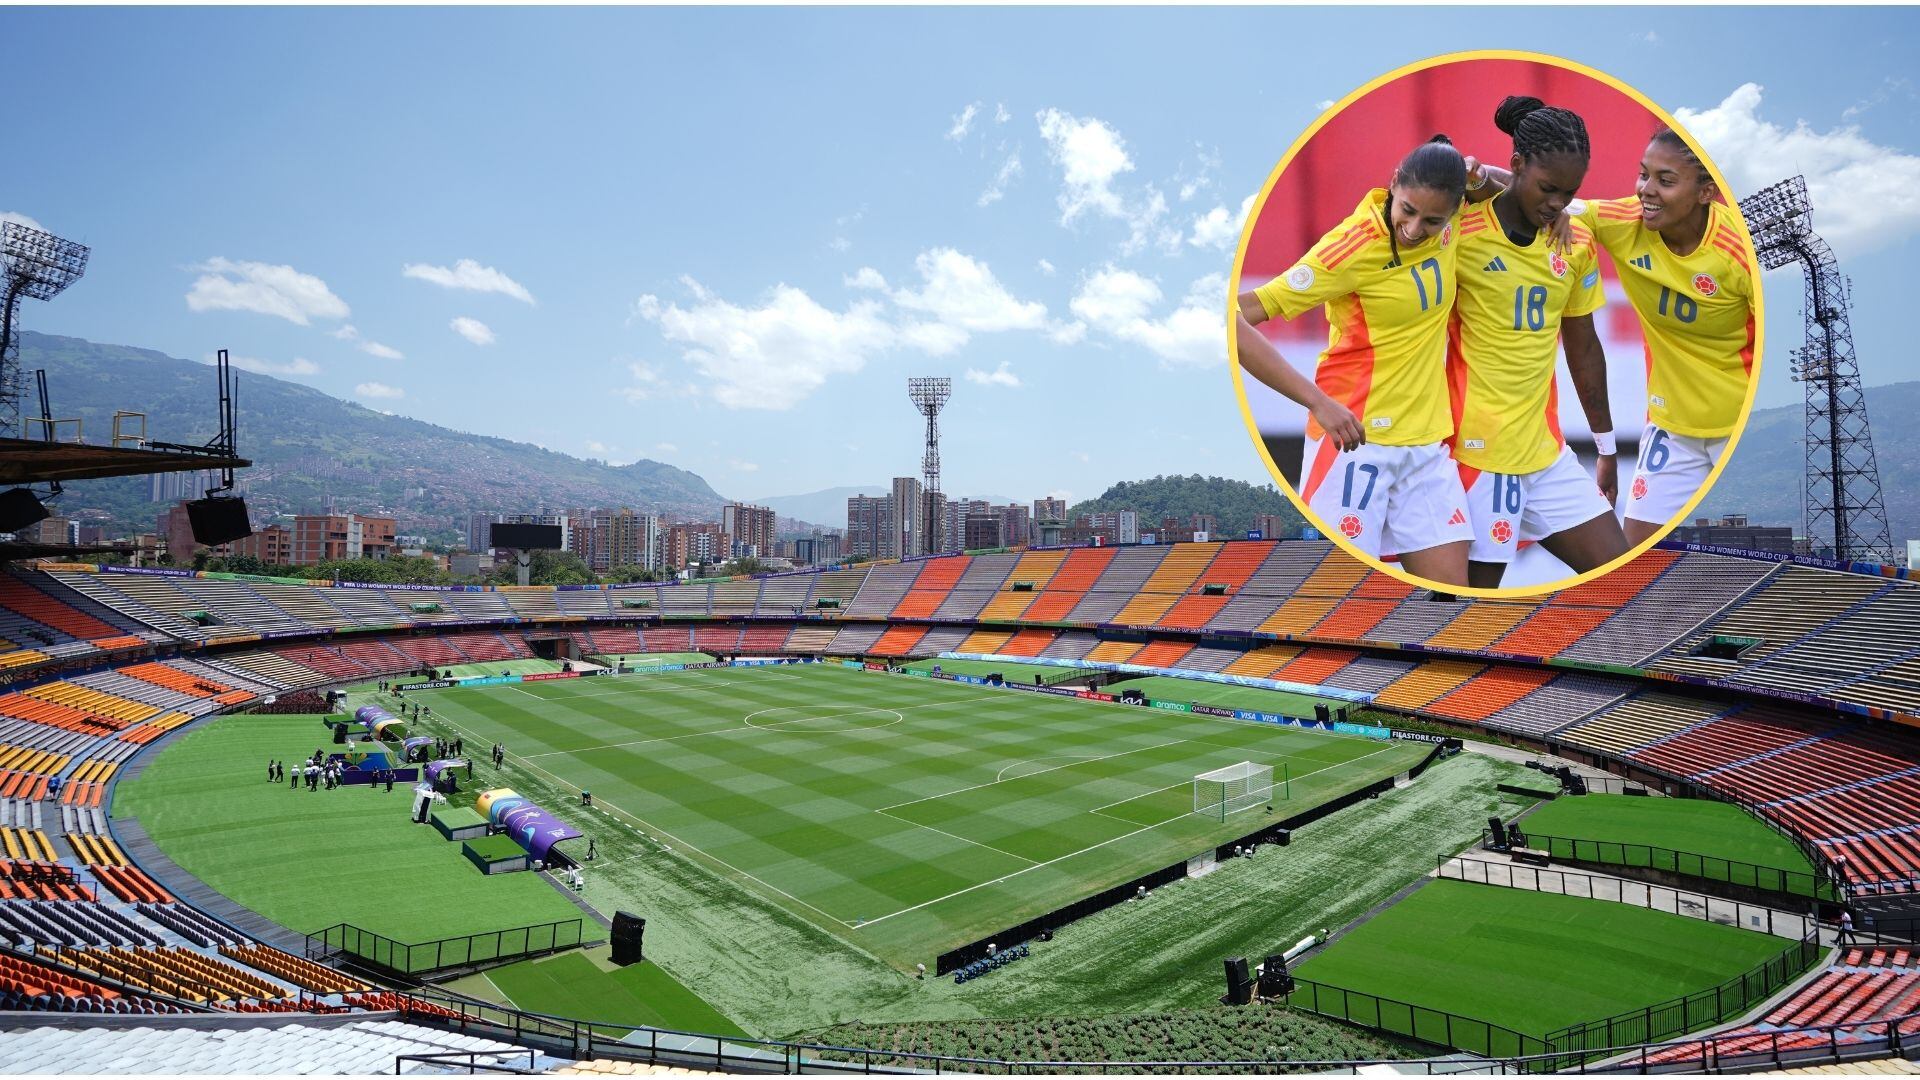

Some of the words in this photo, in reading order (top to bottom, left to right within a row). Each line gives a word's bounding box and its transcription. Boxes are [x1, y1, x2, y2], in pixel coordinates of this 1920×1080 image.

[1410, 257, 1442, 311] 17
[1514, 285, 1547, 332] 18
[1658, 286, 1698, 323] 16
[1638, 426, 1670, 472] 16
[1342, 461, 1378, 510] 17
[1492, 473, 1520, 514] 18
[1716, 547, 1747, 555] WOMEN'S
[1748, 550, 1773, 558] WORLD
[402, 681, 450, 690] FIFASTORE.COM
[1729, 683, 1751, 691] WOMEN'S
[1156, 702, 1185, 710] aramco
[1192, 705, 1209, 713] QATAR
[1211, 707, 1234, 716] AIRWAYS
[1240, 712, 1256, 720] VISA
[1261, 714, 1278, 723] VISA
[1337, 724, 1356, 733] xero
[1367, 727, 1387, 736] xero
